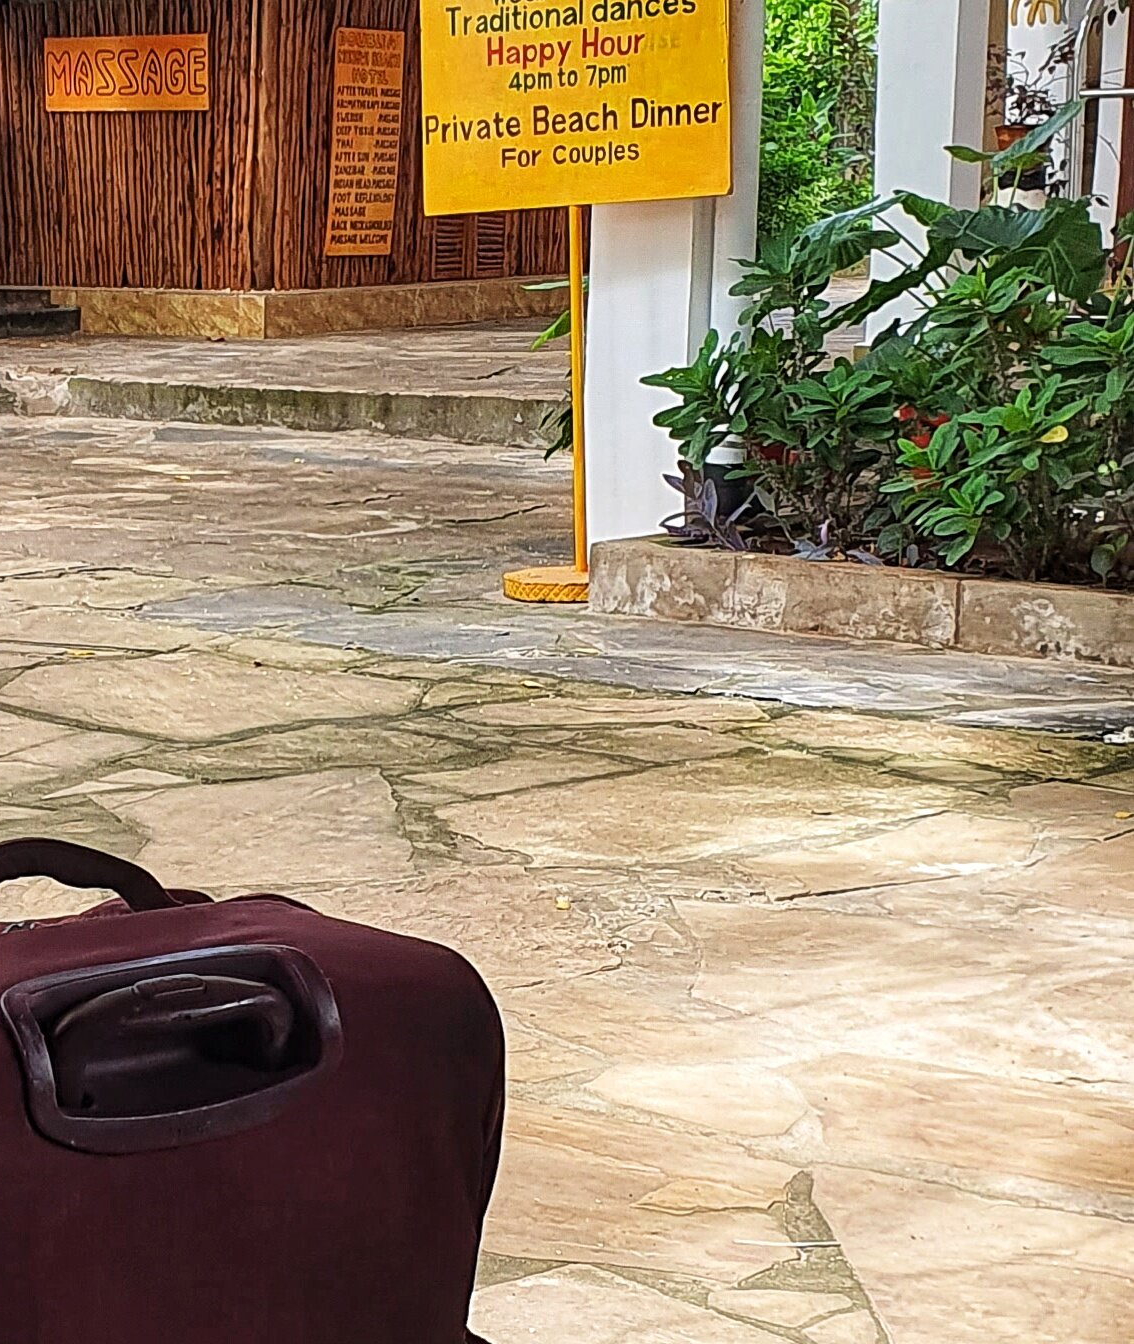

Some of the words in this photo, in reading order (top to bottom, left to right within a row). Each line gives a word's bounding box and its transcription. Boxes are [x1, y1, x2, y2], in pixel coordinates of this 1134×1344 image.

[446, 0, 584, 37] Traditional
[487, 36, 572, 70] Happy
[581, 27, 646, 59] Hour
[46, 47, 207, 97] MASSAGE
[509, 68, 553, 94] 4pm
[557, 67, 579, 87] to
[585, 64, 627, 89] 7pm
[425, 114, 522, 145] Private
[533, 103, 618, 136] Beach
[631, 98, 724, 129] Dinner
[501, 147, 541, 168] For
